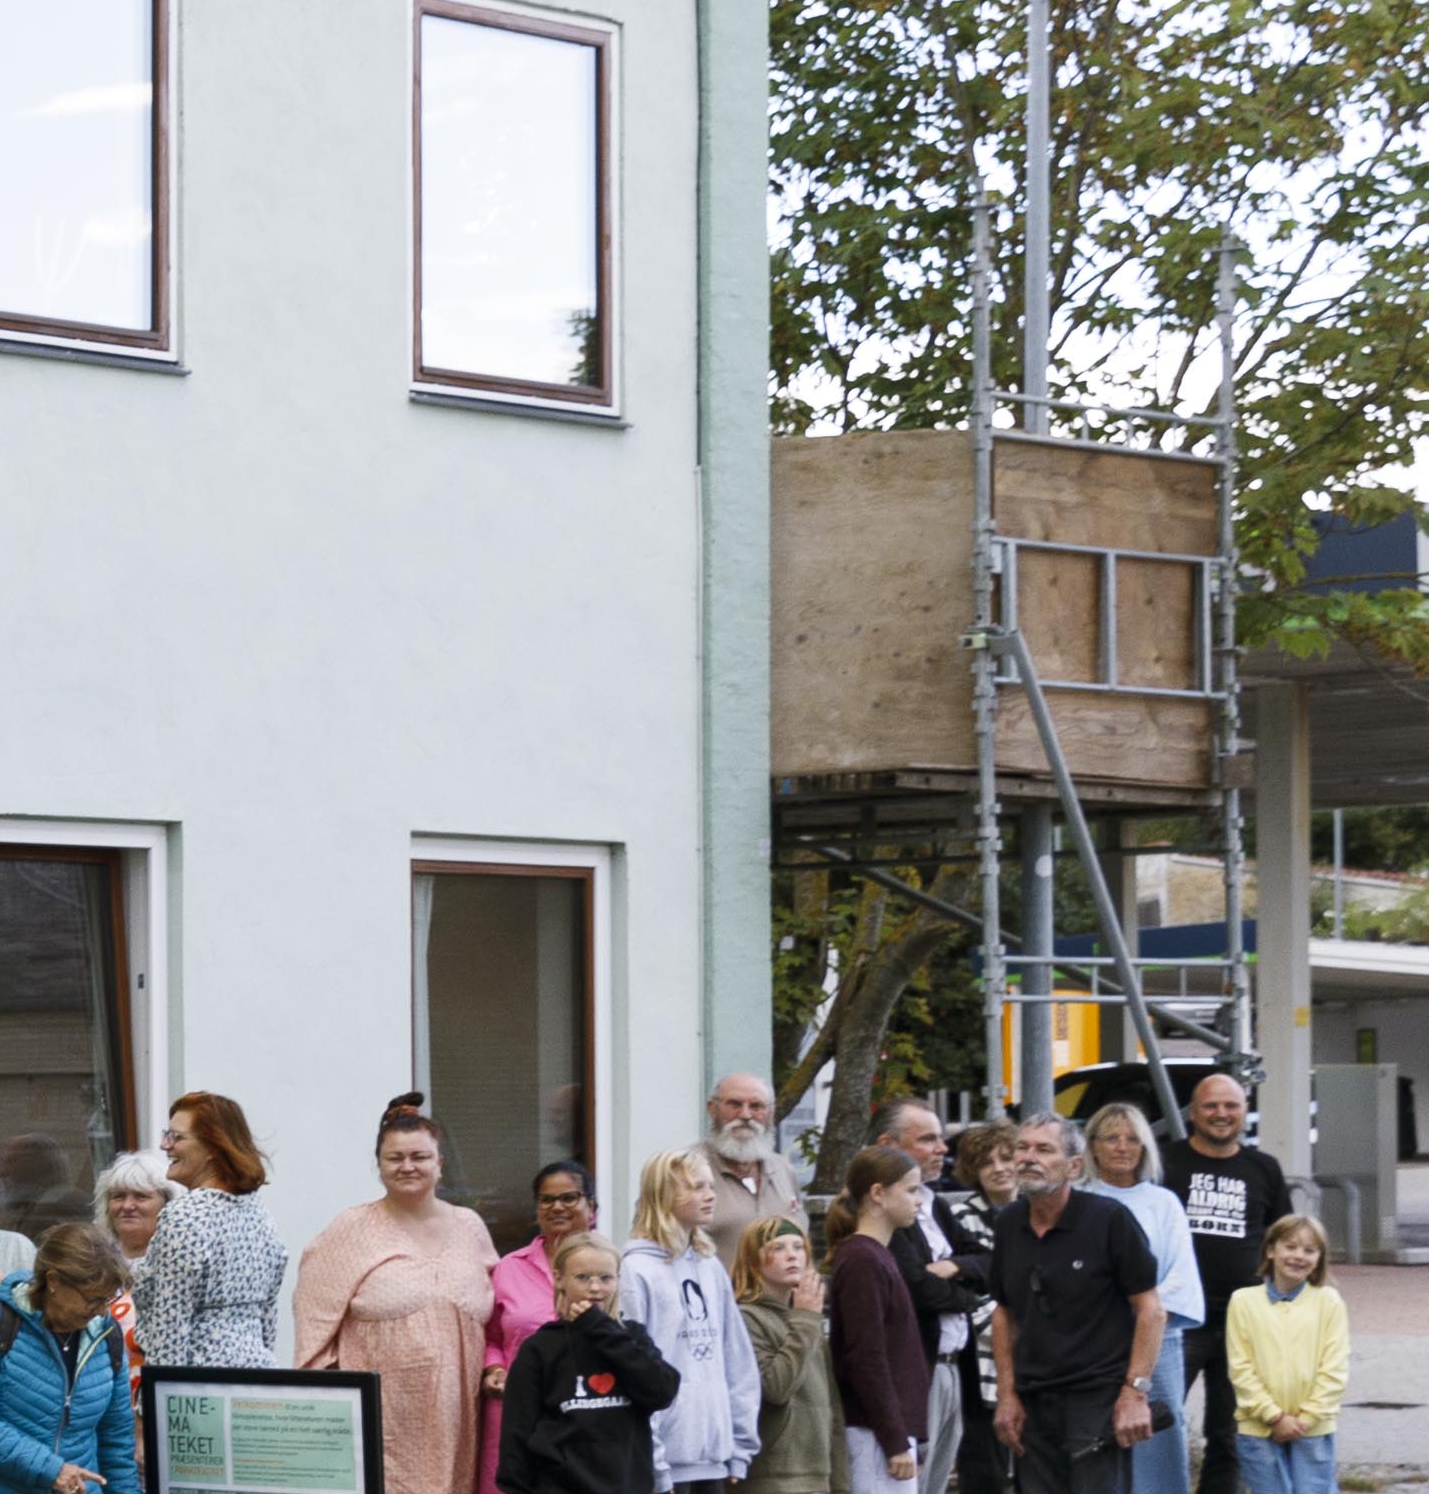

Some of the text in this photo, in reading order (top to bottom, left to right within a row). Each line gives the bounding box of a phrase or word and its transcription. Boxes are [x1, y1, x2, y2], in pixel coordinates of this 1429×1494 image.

[1188, 1173, 1247, 1196] JEG HAR
[1187, 1190, 1247, 1213] ALDRIG
[575, 1375, 587, 1397] I
[166, 1395, 216, 1415] CINE-
[167, 1416, 192, 1433] MA
[167, 1435, 215, 1455] TEKET
